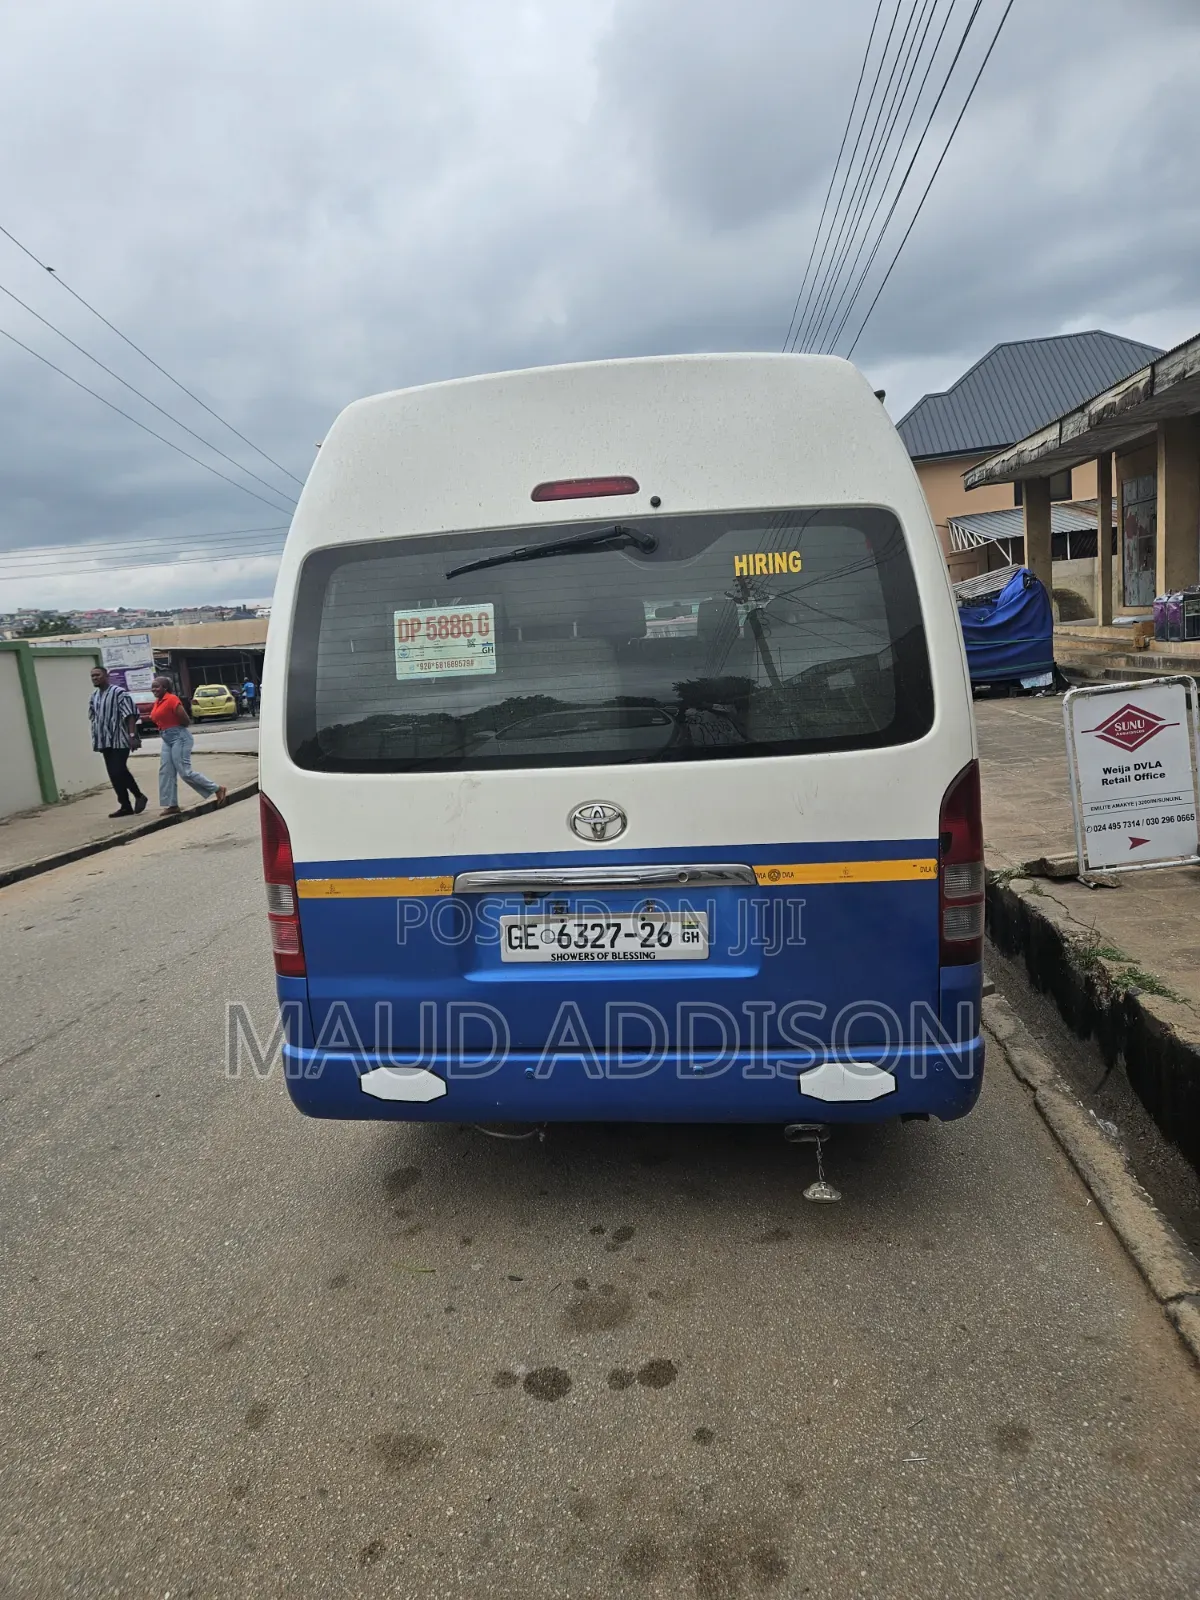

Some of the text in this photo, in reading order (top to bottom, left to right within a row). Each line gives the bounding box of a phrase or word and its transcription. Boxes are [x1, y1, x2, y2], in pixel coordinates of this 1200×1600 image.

[734, 550, 802, 577] HIRING
[397, 612, 490, 644] DP 5886 G
[482, 646, 494, 654] GH
[1114, 719, 1145, 732] SUNU
[1102, 760, 1163, 775] Weija DVLA
[1101, 772, 1166, 786] Retail Office
[1093, 824, 1107, 833] 024
[1108, 822, 1122, 831] 495
[1123, 819, 1140, 829] 7314
[1146, 817, 1160, 826] 030
[1161, 815, 1175, 824] 296
[1176, 813, 1195, 822] 0665
[507, 922, 673, 950] GE 6327-26
[682, 930, 700, 943] GH
[550, 951, 656, 961] SHOWERS OF BLESSING
